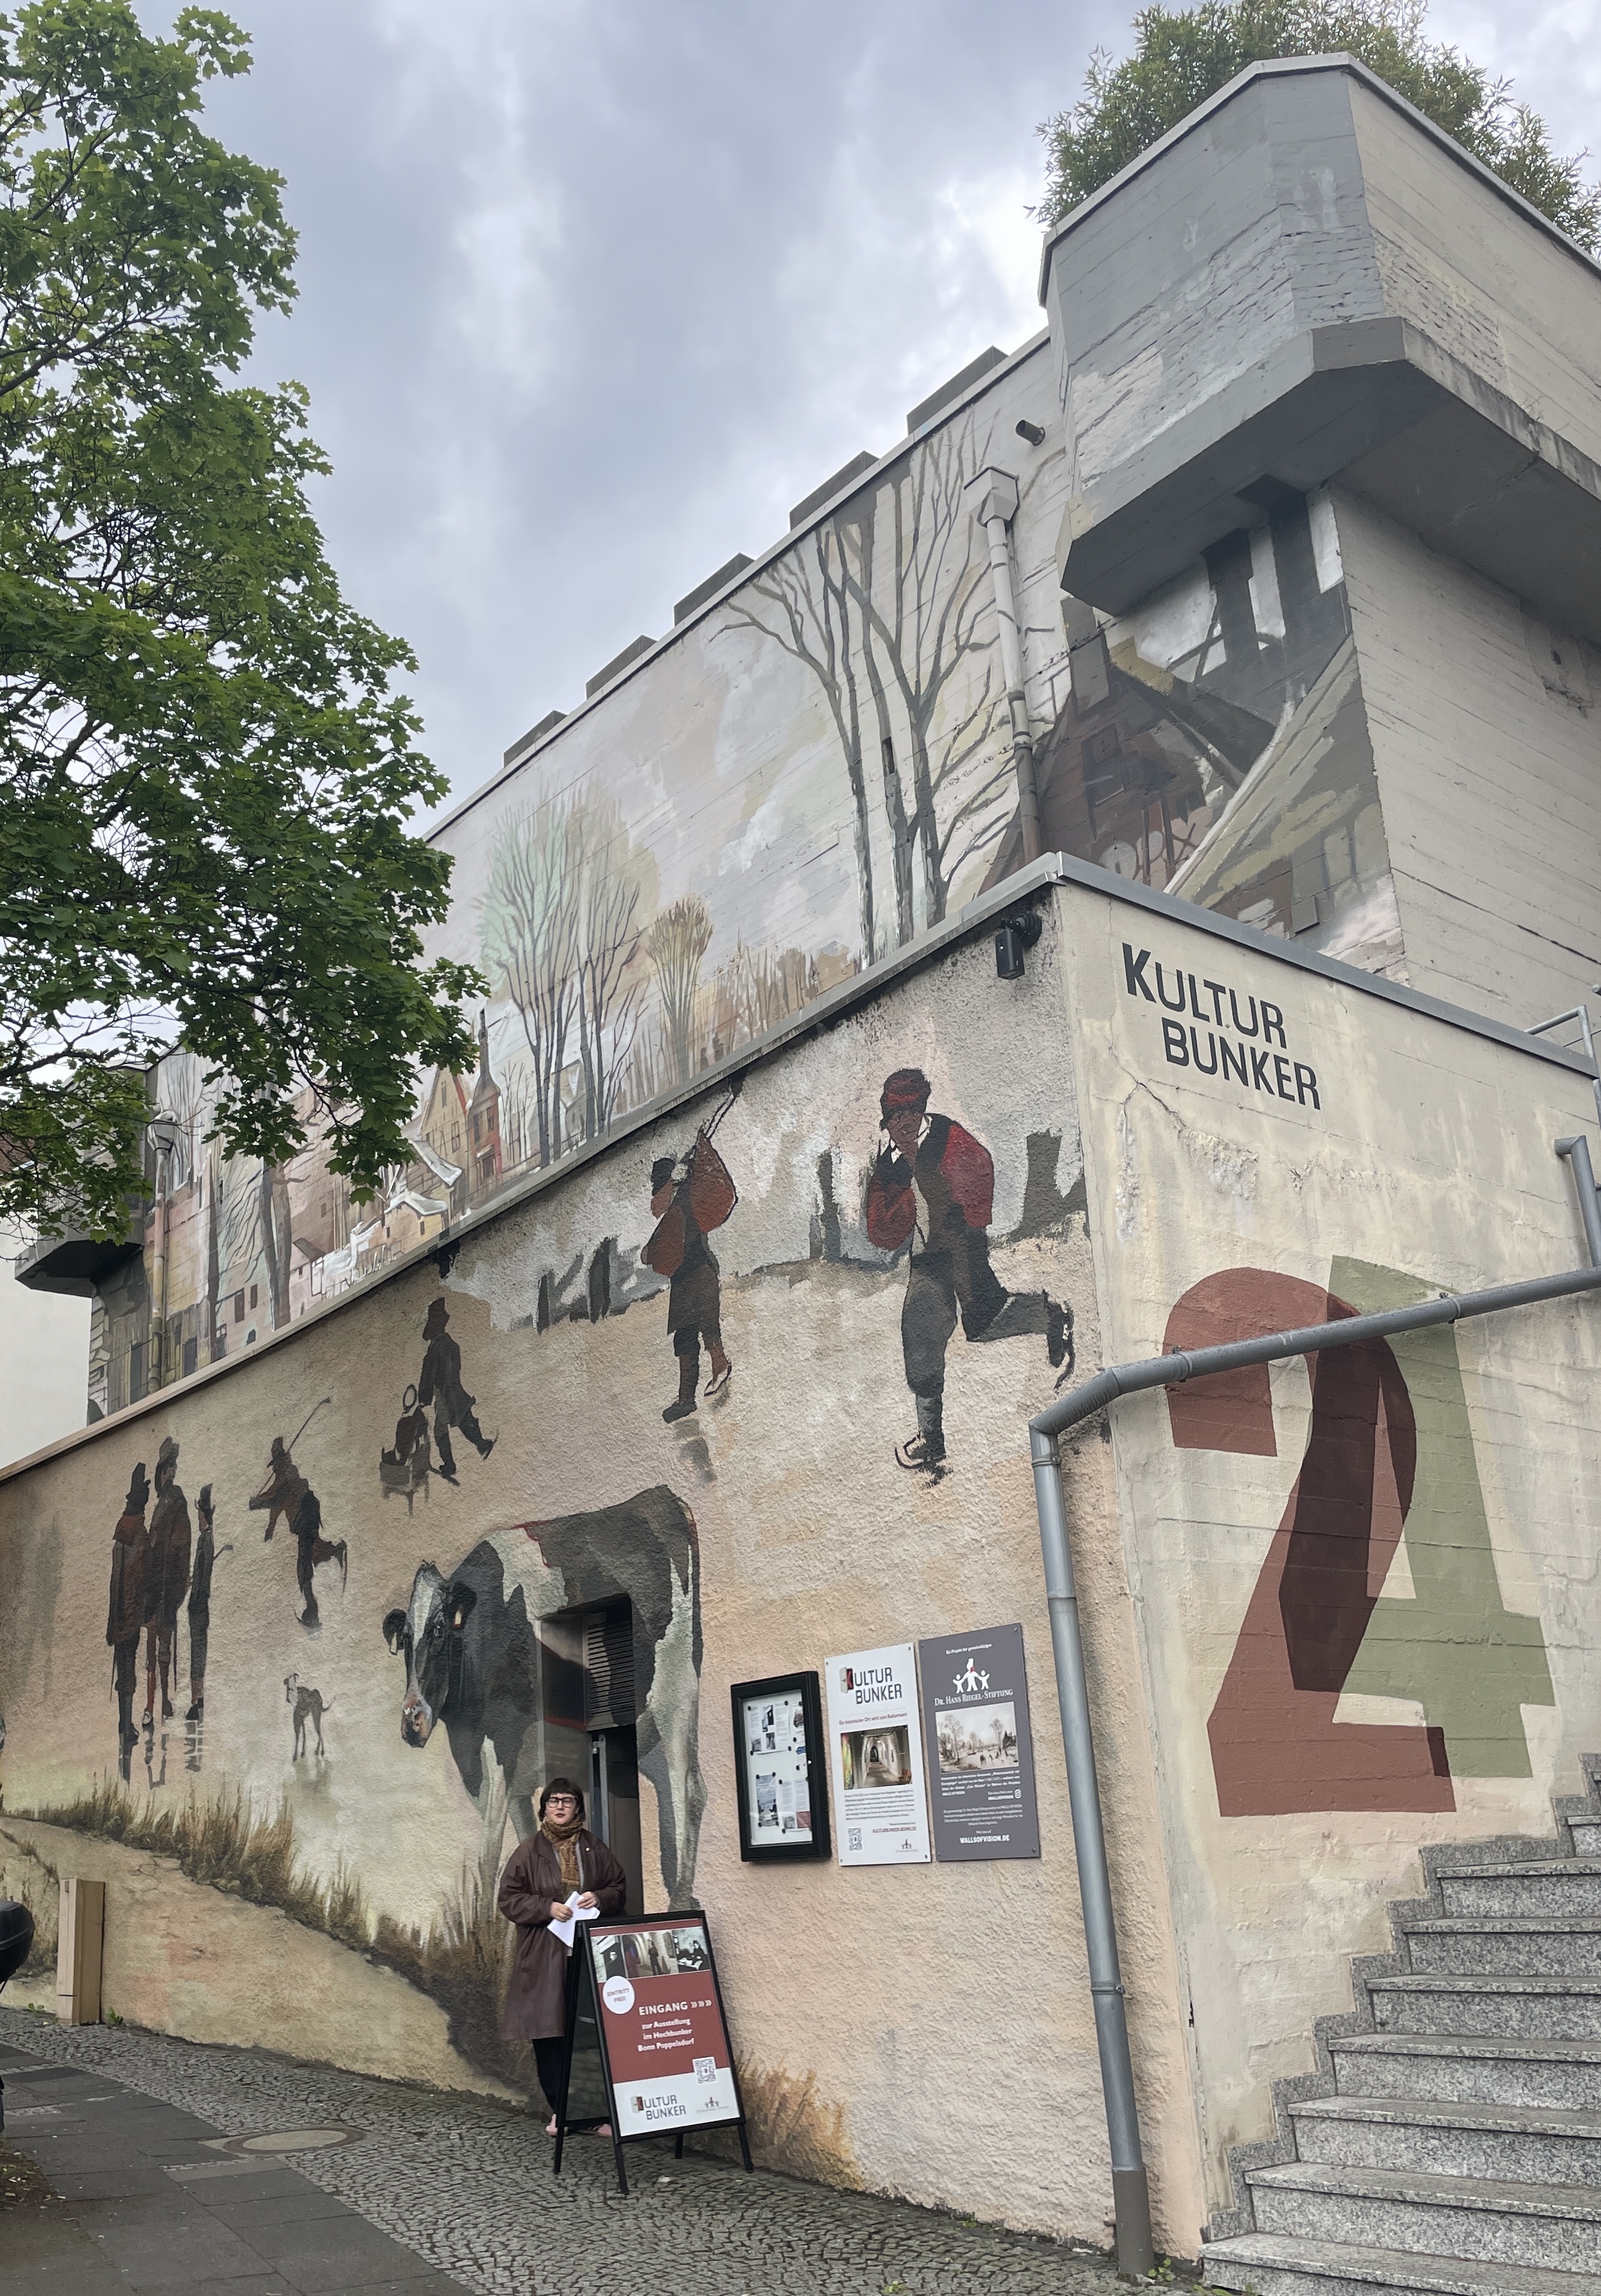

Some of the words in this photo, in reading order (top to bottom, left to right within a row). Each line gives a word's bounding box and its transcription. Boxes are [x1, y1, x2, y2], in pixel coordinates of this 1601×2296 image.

[1122, 942, 1287, 1049] KULTUR
[1162, 1017, 1321, 1110] BUNKER
[855, 1683, 903, 1705] BUNKER
[638, 2001, 688, 2015] EINGANG
[654, 2018, 691, 2029] Ausstellung
[646, 2105, 687, 2121] BUNKER
